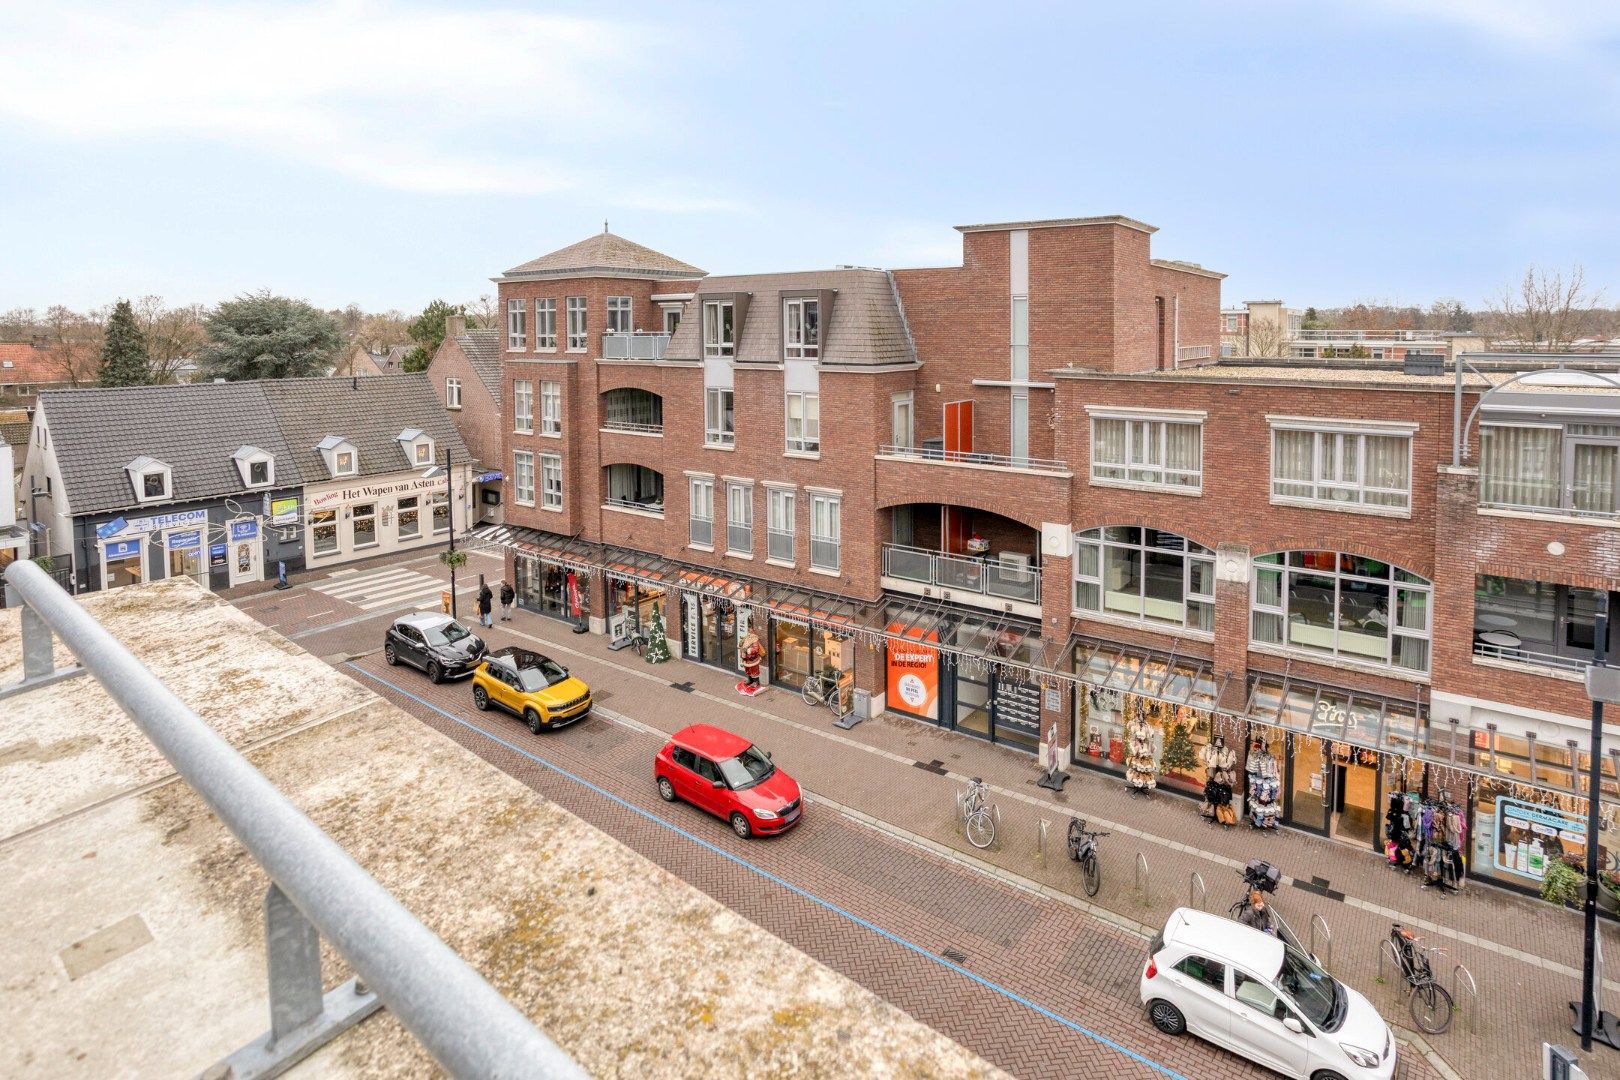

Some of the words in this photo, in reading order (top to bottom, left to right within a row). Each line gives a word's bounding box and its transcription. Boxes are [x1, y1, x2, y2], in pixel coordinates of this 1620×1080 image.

[342, 489, 360, 500] Het
[362, 485, 393, 497] Wapen
[394, 482, 409, 492] van
[410, 479, 435, 490] Asten
[313, 492, 338, 504] Bowling
[151, 511, 205, 525] TELECOM
[895, 653, 905, 661] DE
[906, 654, 933, 663] EXPERT
[898, 660, 907, 668] DE
[906, 661, 927, 669] REGIO!
